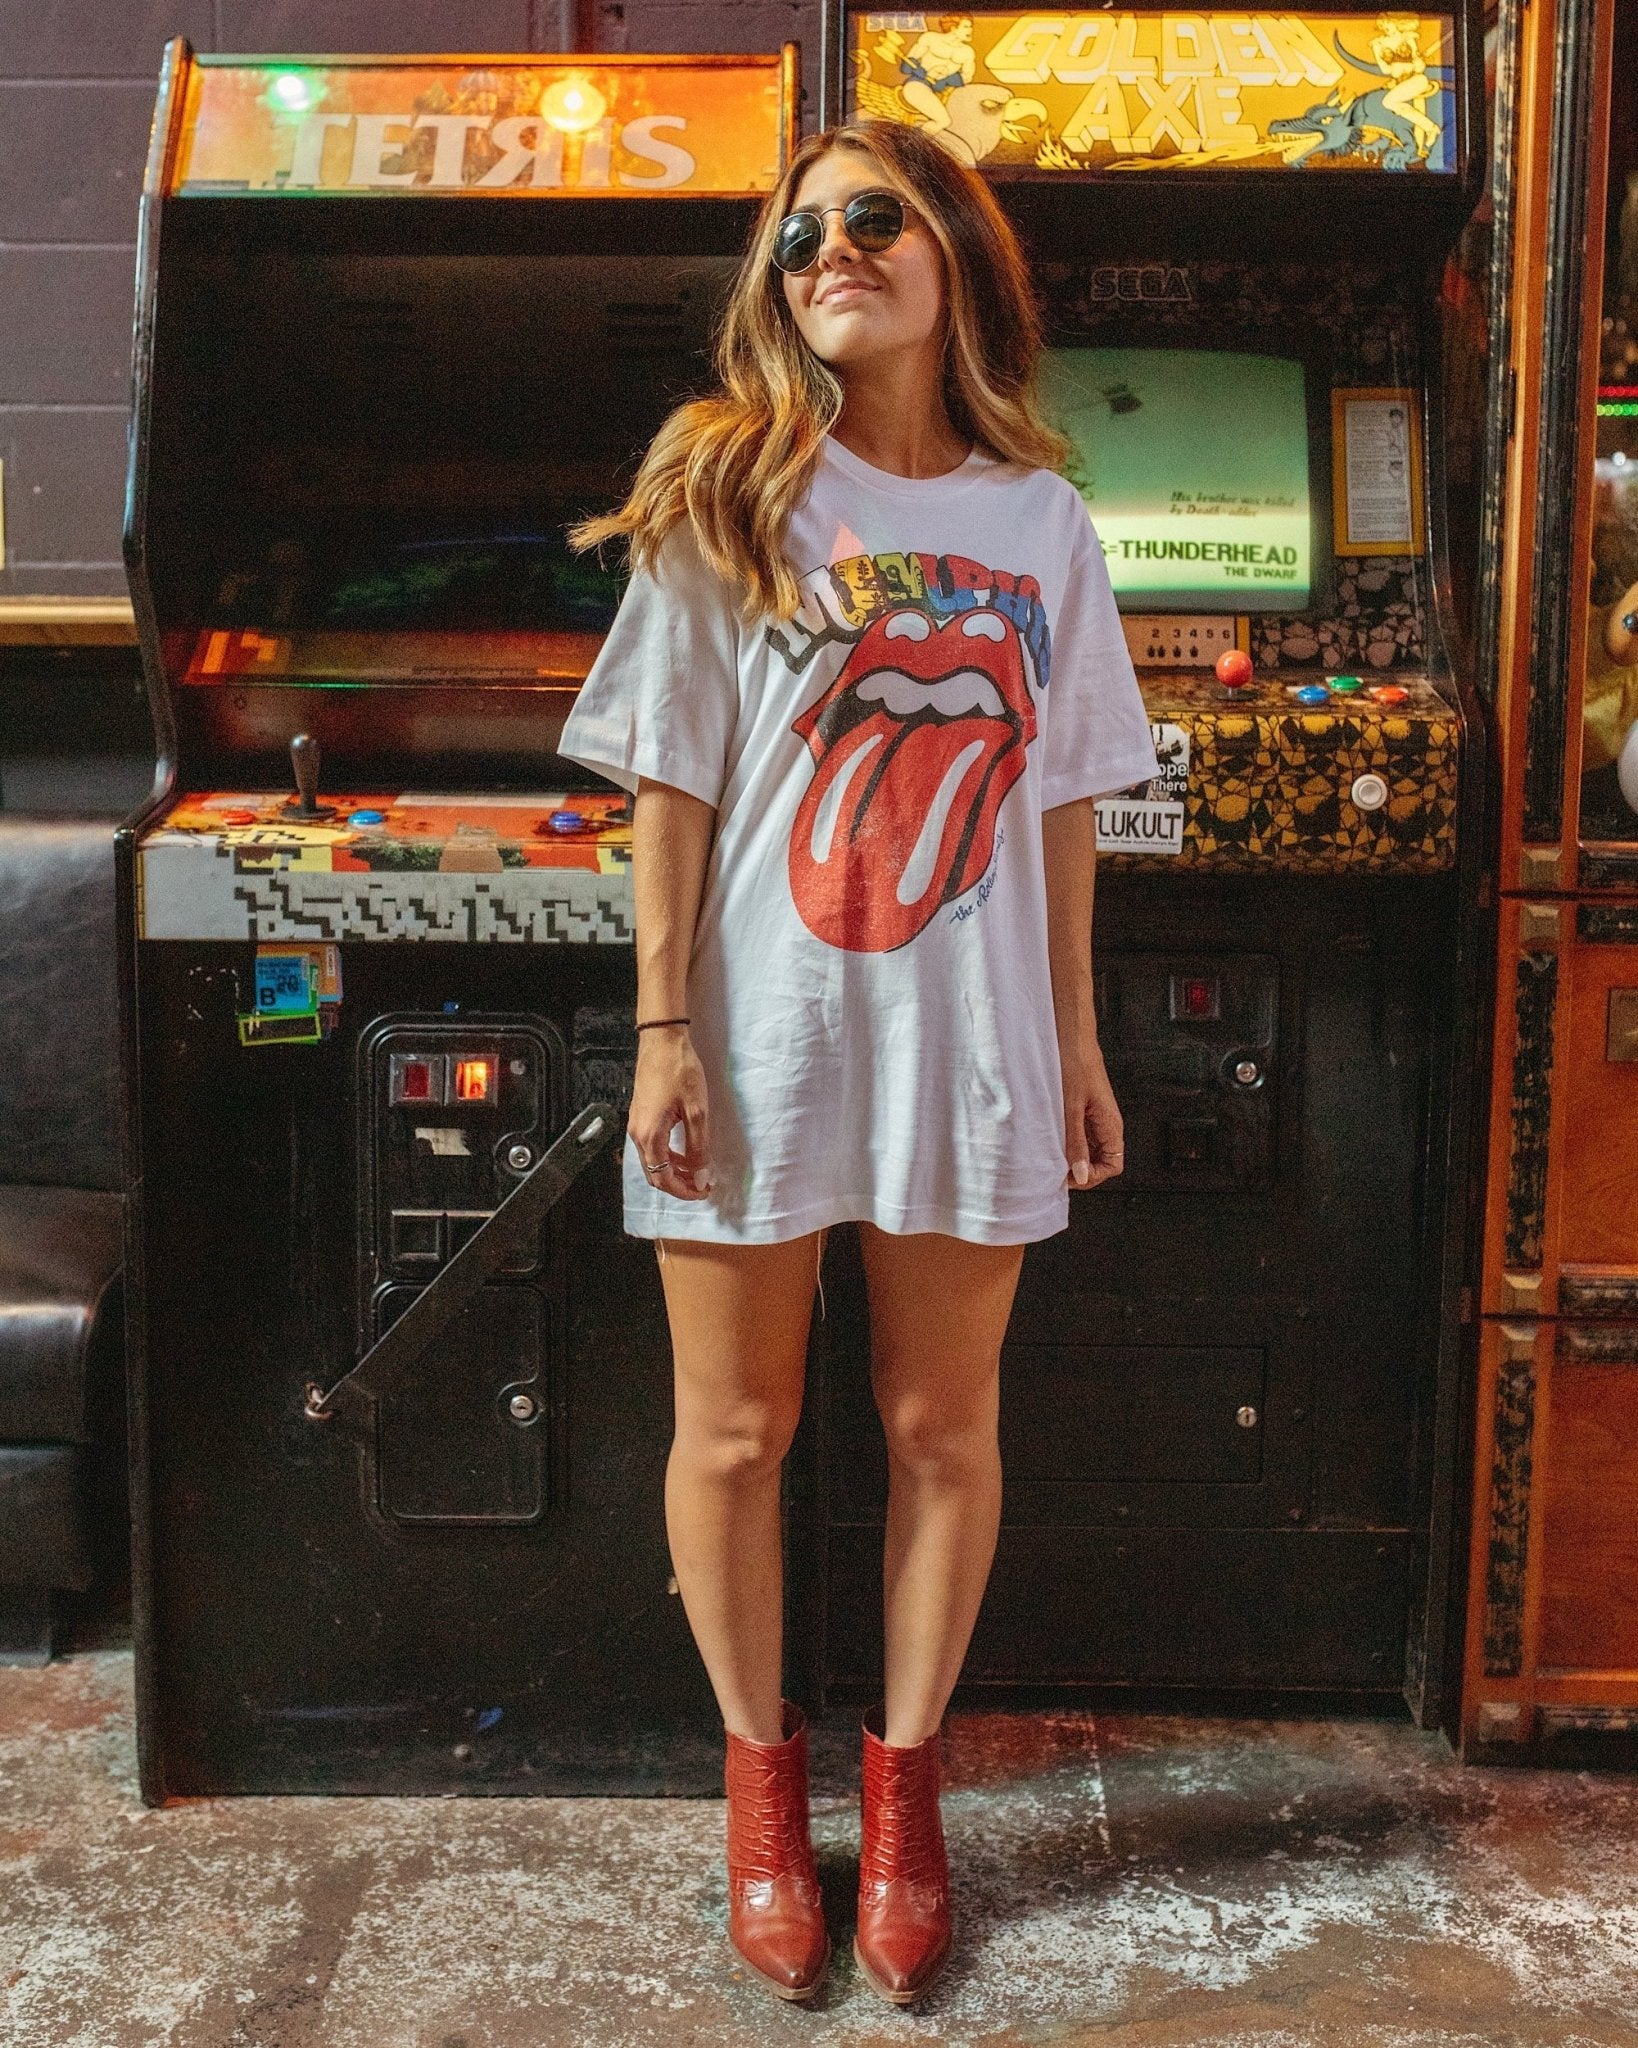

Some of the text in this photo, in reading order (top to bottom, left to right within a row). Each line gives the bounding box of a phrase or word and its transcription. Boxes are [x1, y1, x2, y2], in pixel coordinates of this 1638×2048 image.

[866, 11, 928, 32] SEGA
[984, 13, 1346, 88] GOLDEN
[1061, 75, 1262, 154] AXE
[1091, 266, 1192, 301] SEGA
[1224, 566, 1298, 580] THE DWARF
[1152, 628, 1231, 640] 2 3 4 5 6
[1152, 778, 1187, 792] There
